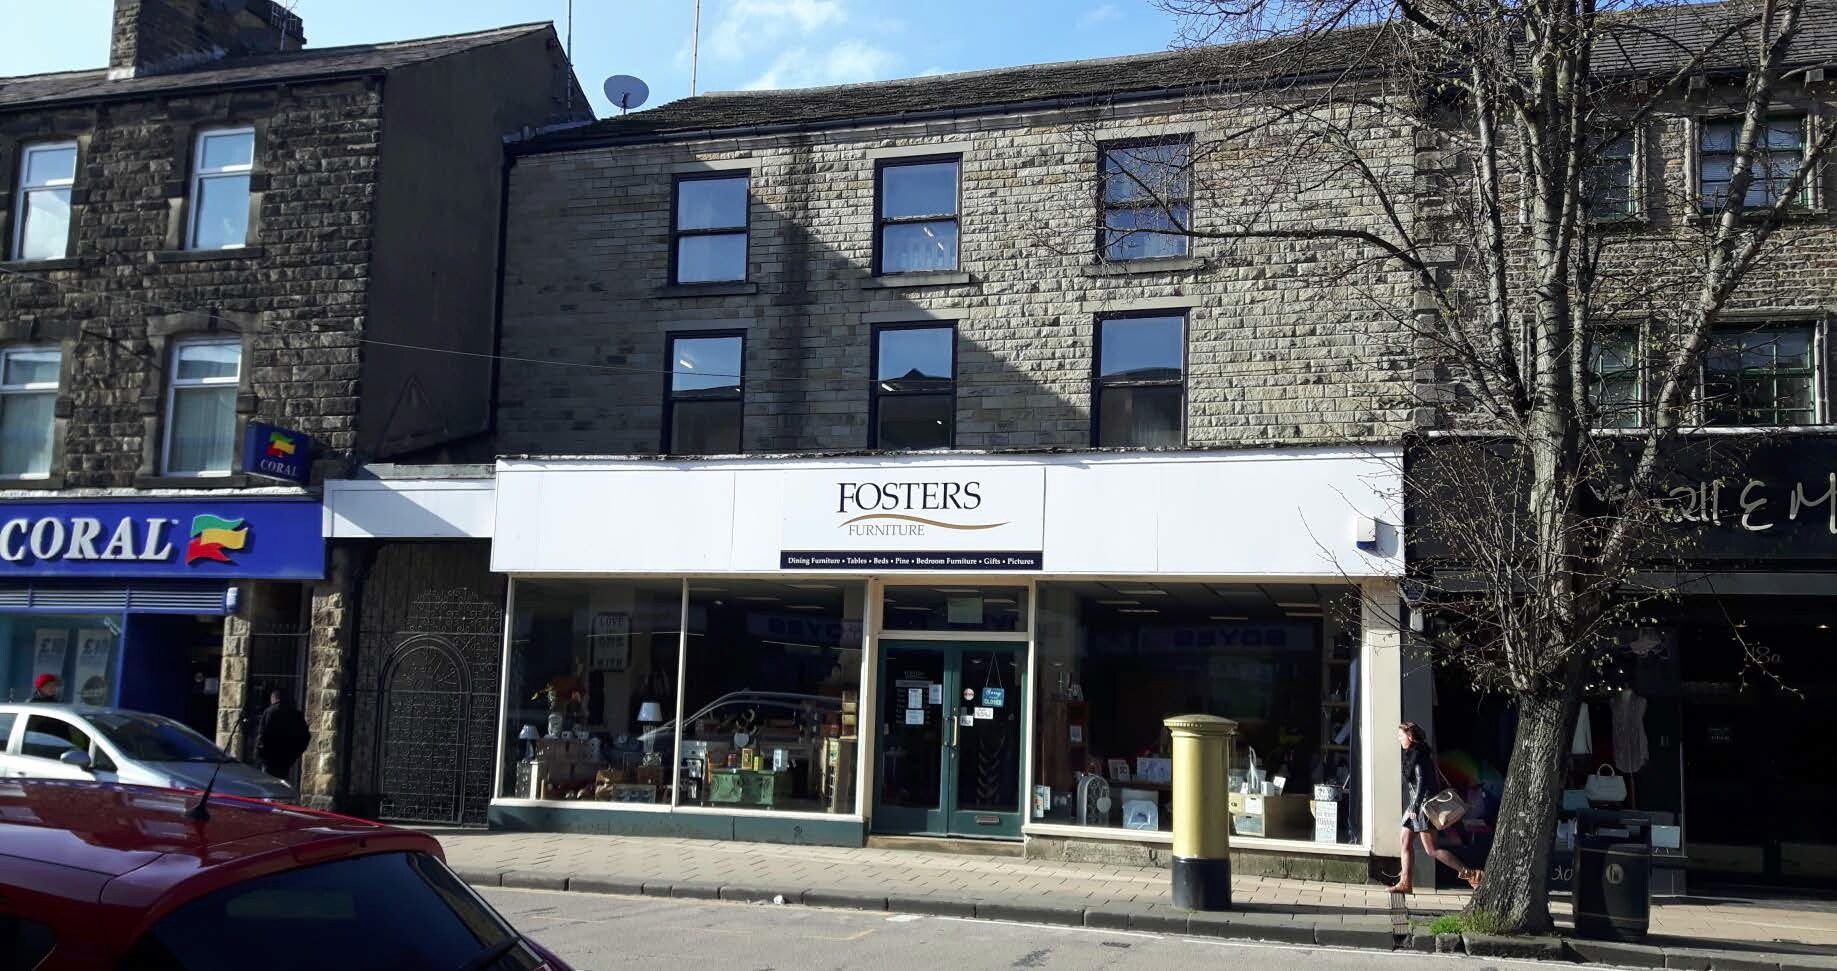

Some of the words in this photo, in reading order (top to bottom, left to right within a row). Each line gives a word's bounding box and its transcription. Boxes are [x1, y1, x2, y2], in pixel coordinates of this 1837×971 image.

[260, 459, 297, 477] CORAL
[838, 481, 982, 513] FOSTERS
[1, 516, 172, 560] CORAL
[848, 524, 925, 536] FURNITURE
[788, 557, 810, 566] Dining
[811, 557, 840, 565] Furniture
[846, 557, 867, 565] Tables
[873, 557, 889, 565] Beds
[895, 557, 910, 565] Pine
[916, 557, 945, 565] Bedroom
[946, 557, 977, 565] Furniture
[984, 557, 1001, 565] Gifts
[1007, 557, 1034, 565] Pictures
